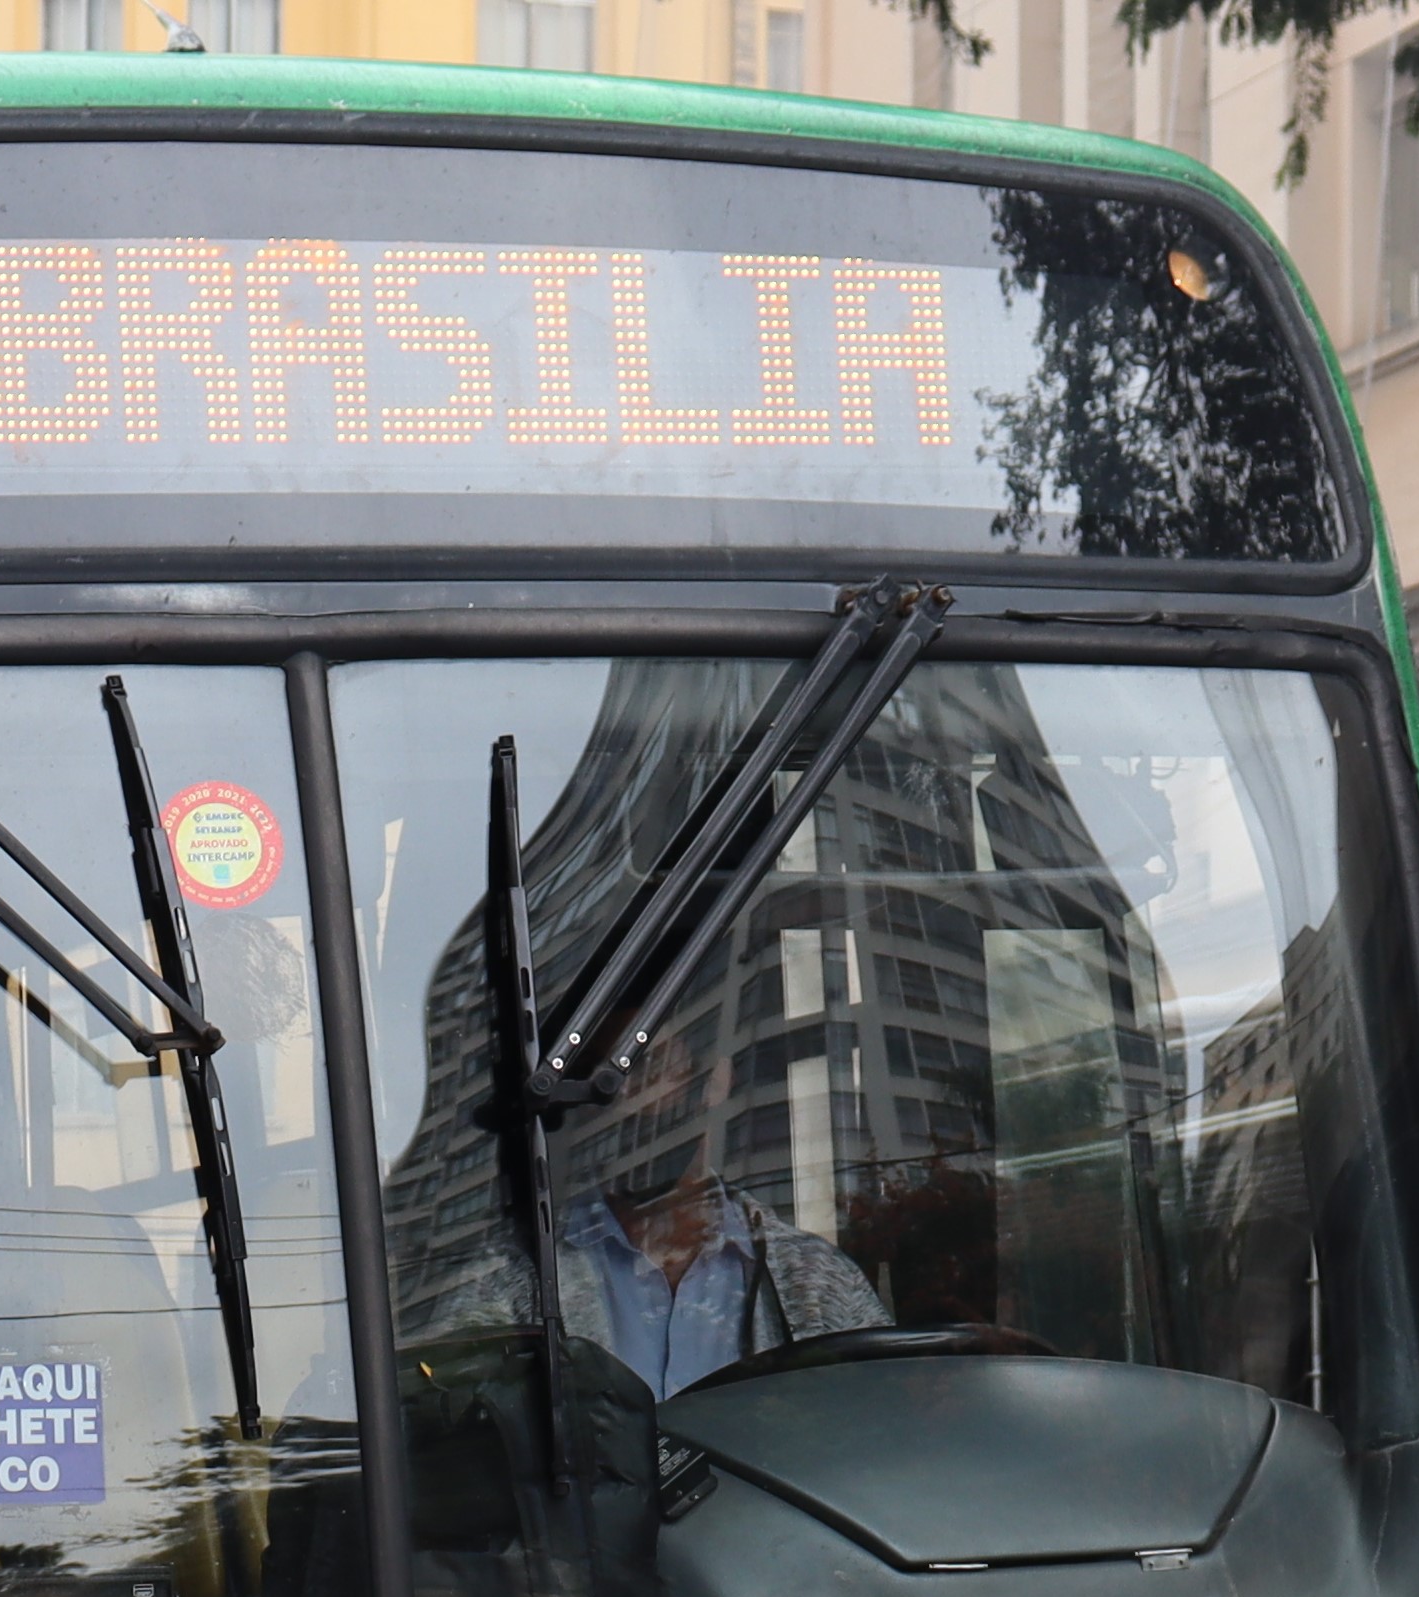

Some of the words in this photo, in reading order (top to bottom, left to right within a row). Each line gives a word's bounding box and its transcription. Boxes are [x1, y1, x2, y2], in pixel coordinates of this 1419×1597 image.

[182, 788, 210, 806] 2020
[218, 788, 246, 805] 2021
[190, 839, 248, 849] APROVADO
[187, 851, 255, 862] INTERCAMP
